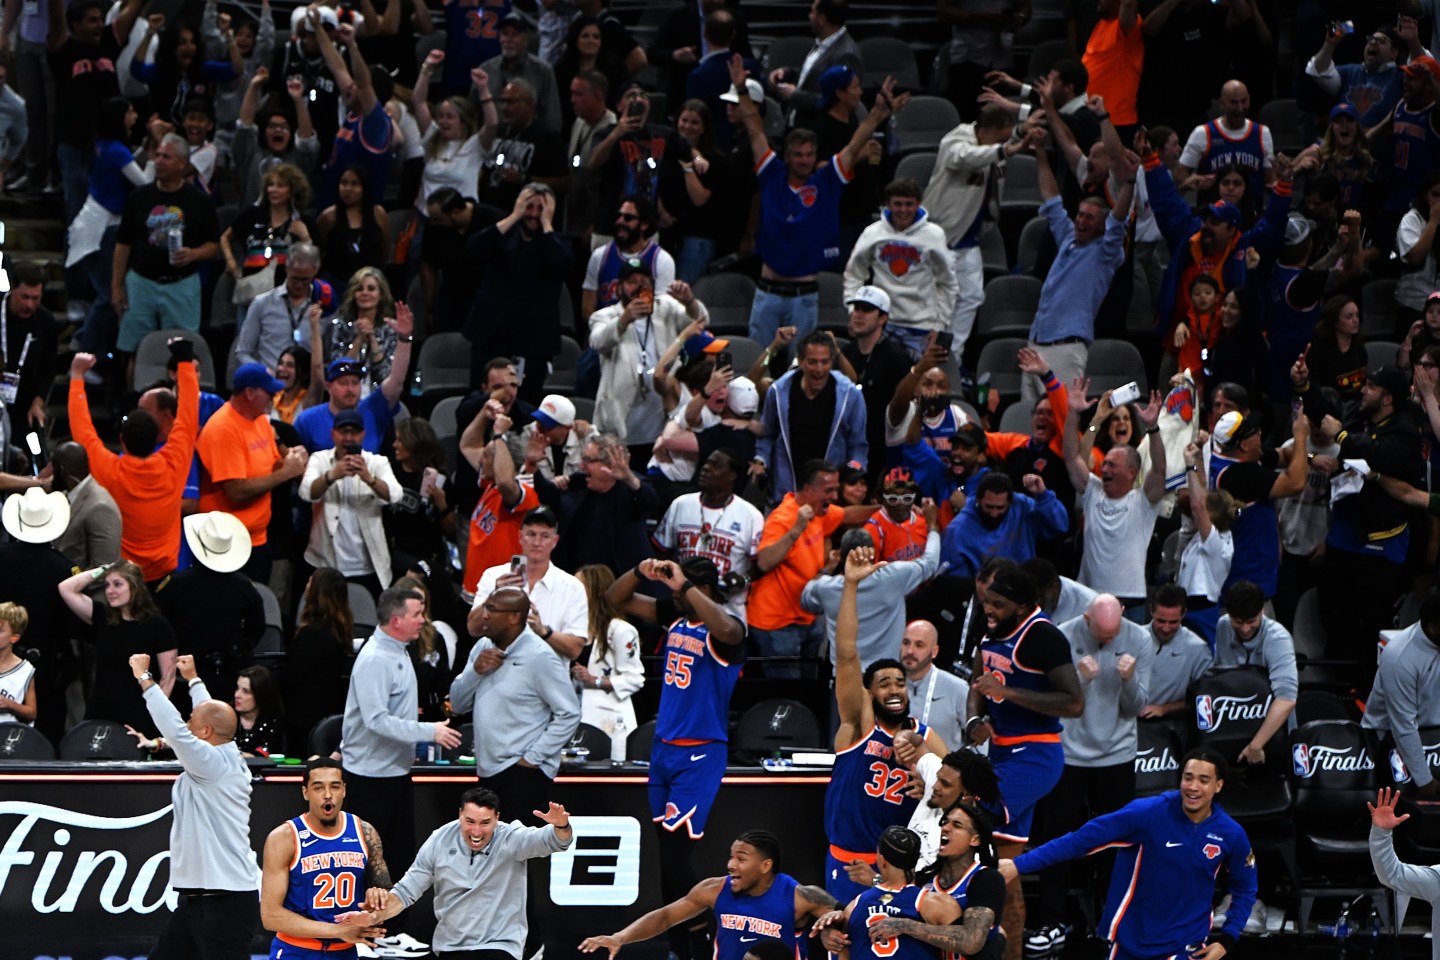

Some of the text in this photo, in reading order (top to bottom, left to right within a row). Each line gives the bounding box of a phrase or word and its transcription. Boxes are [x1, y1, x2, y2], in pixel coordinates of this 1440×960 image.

[464, 10, 500, 40] 32
[1210, 151, 1260, 171] NEW YORK
[664, 650, 695, 690] 55
[1205, 694, 1272, 733] Final
[1300, 744, 1375, 779] Finals
[863, 760, 910, 806] 32
[301, 851, 365, 874] NEW YORK
[312, 871, 357, 910] 20
[720, 913, 782, 939] NEW YORK
